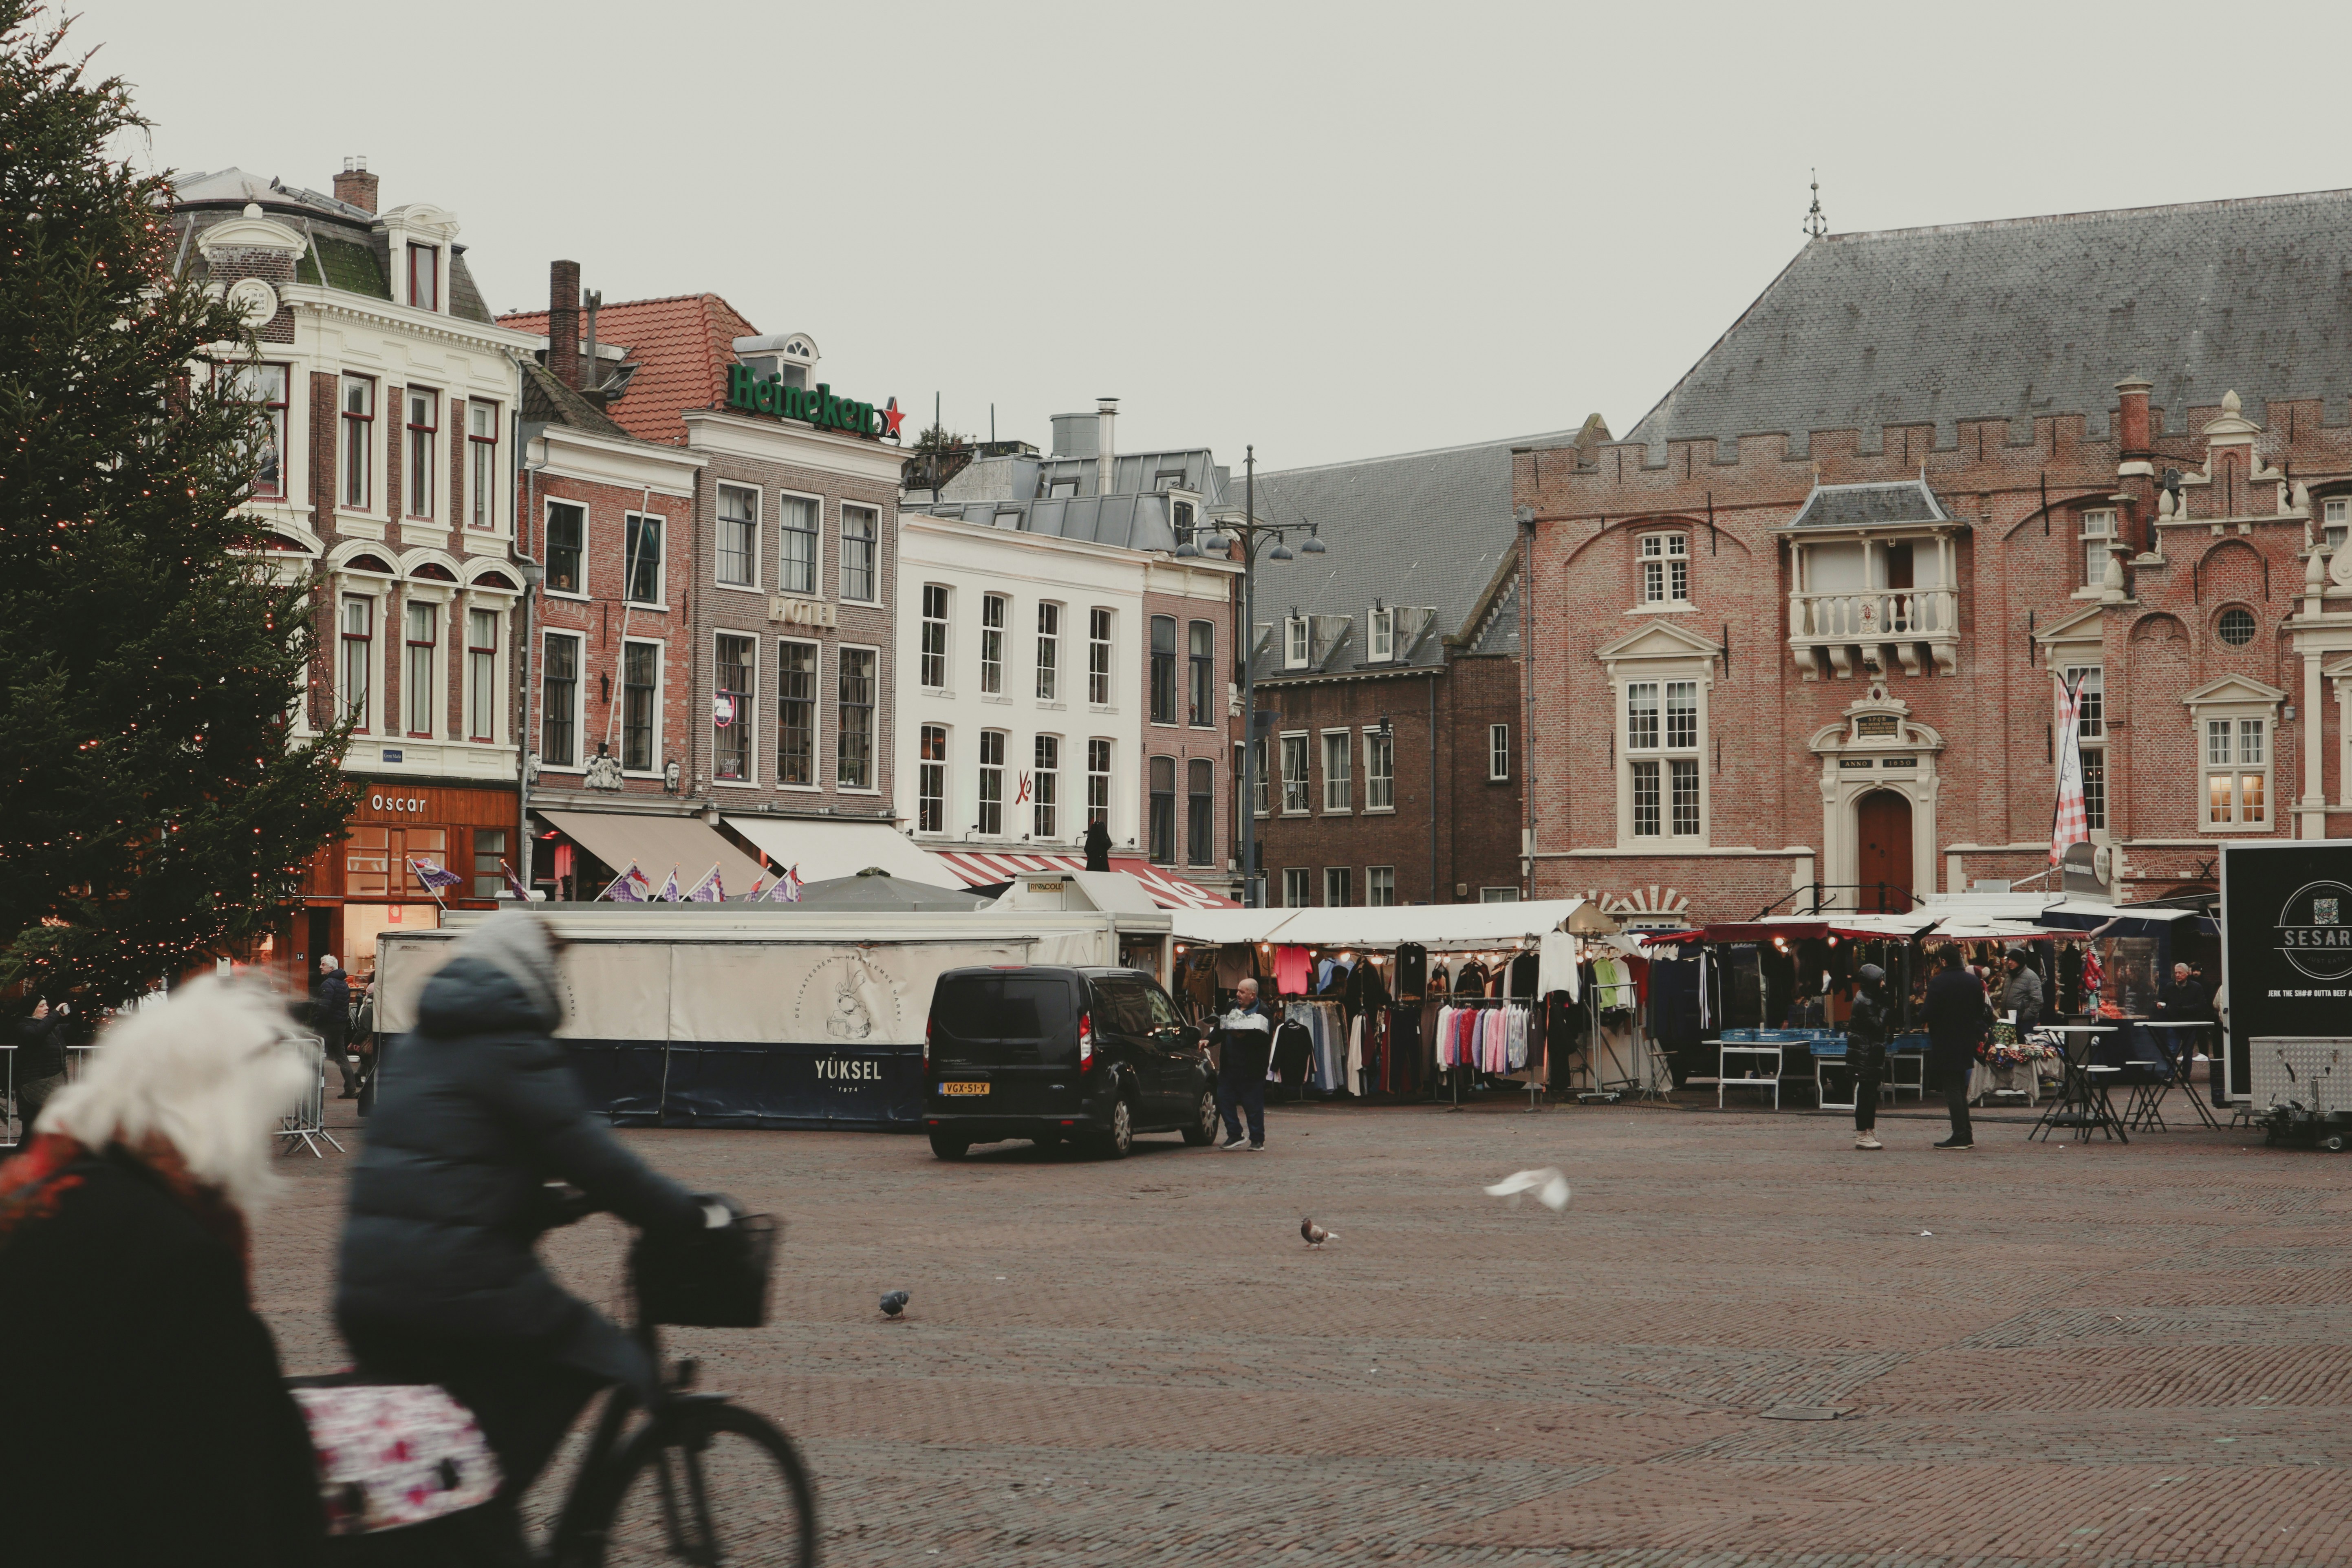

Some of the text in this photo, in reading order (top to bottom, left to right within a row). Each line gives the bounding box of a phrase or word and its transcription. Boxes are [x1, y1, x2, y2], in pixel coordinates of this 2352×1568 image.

[725, 363, 878, 434] Heineken
[769, 596, 840, 628] HOTEL
[371, 794, 426, 813] Oscar
[2328, 955, 2345, 964] EATS
[567, 986, 575, 1017] MARKT
[795, 958, 832, 1018] DELICATESSEN
[893, 990, 901, 1022] MARKT
[815, 1056, 882, 1080] YÜKSEL
[947, 1084, 986, 1093] VGX-51-X
